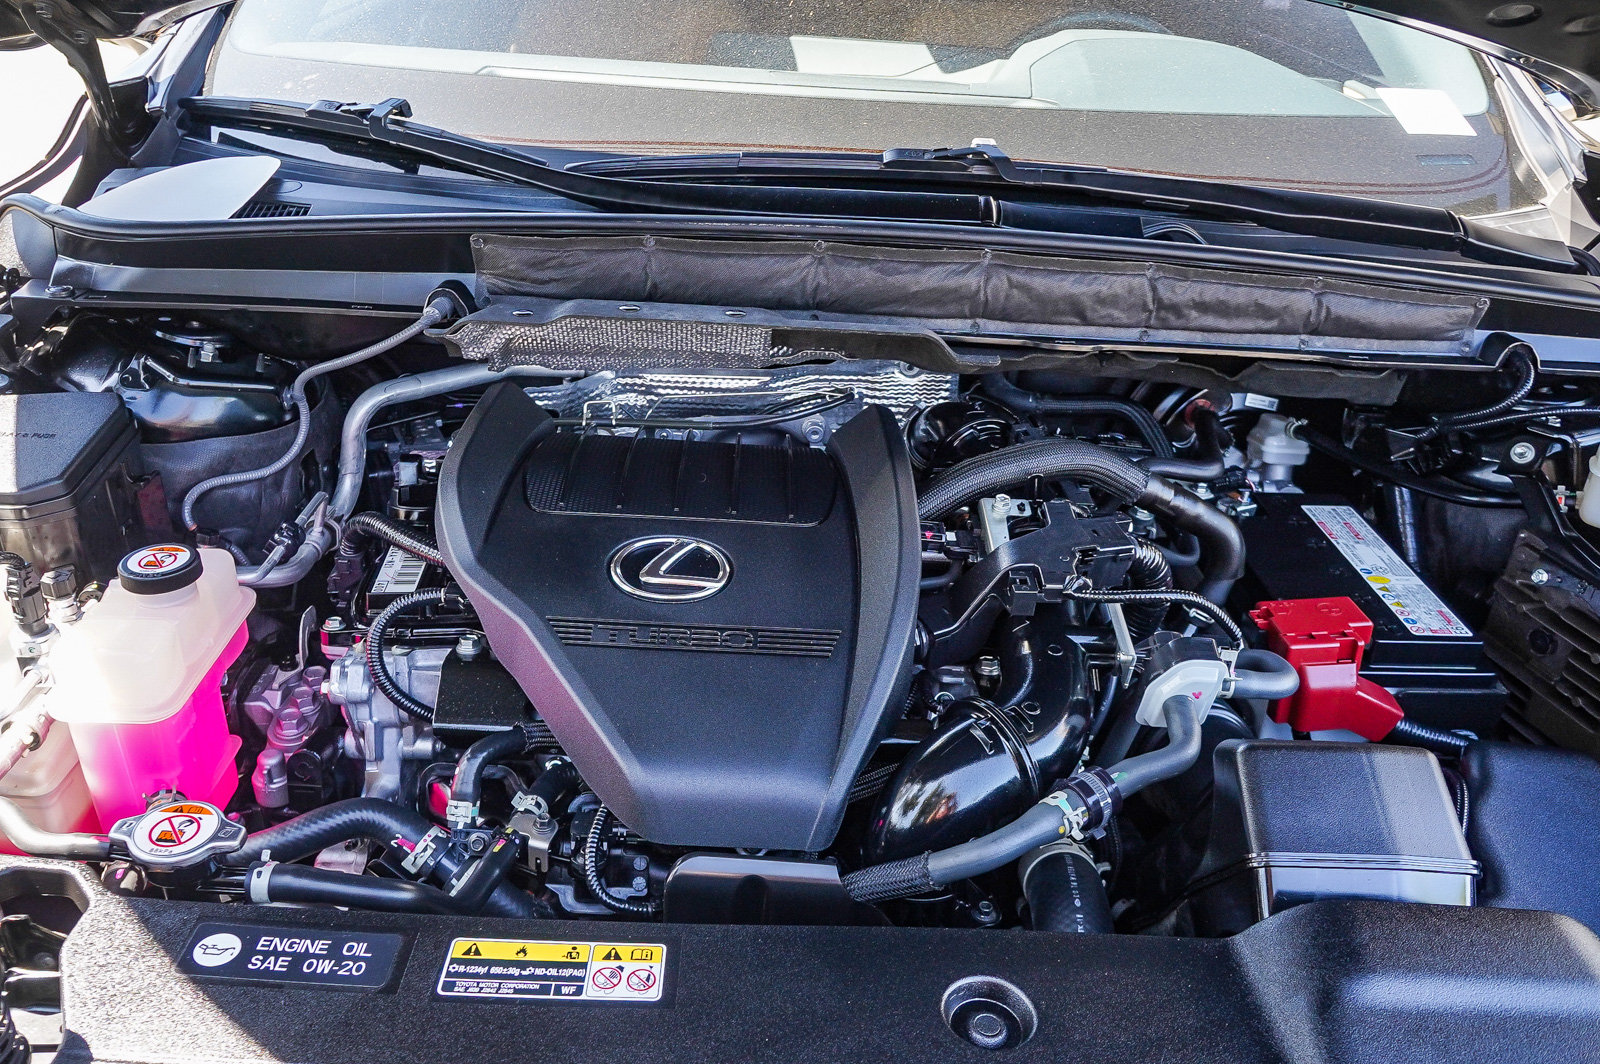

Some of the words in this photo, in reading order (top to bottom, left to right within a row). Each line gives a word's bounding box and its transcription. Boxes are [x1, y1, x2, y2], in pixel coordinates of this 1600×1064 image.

[597, 625, 753, 647] TURBO
[256, 936, 332, 955] ENGINE
[342, 942, 373, 958] OIL
[247, 955, 292, 972] SAE
[302, 958, 366, 976] 0W-20
[458, 965, 488, 975] R-1234yf
[491, 966, 520, 976] 650±30g
[535, 967, 585, 977] ND-OIL12(PAG)
[561, 985, 576, 995] WF
